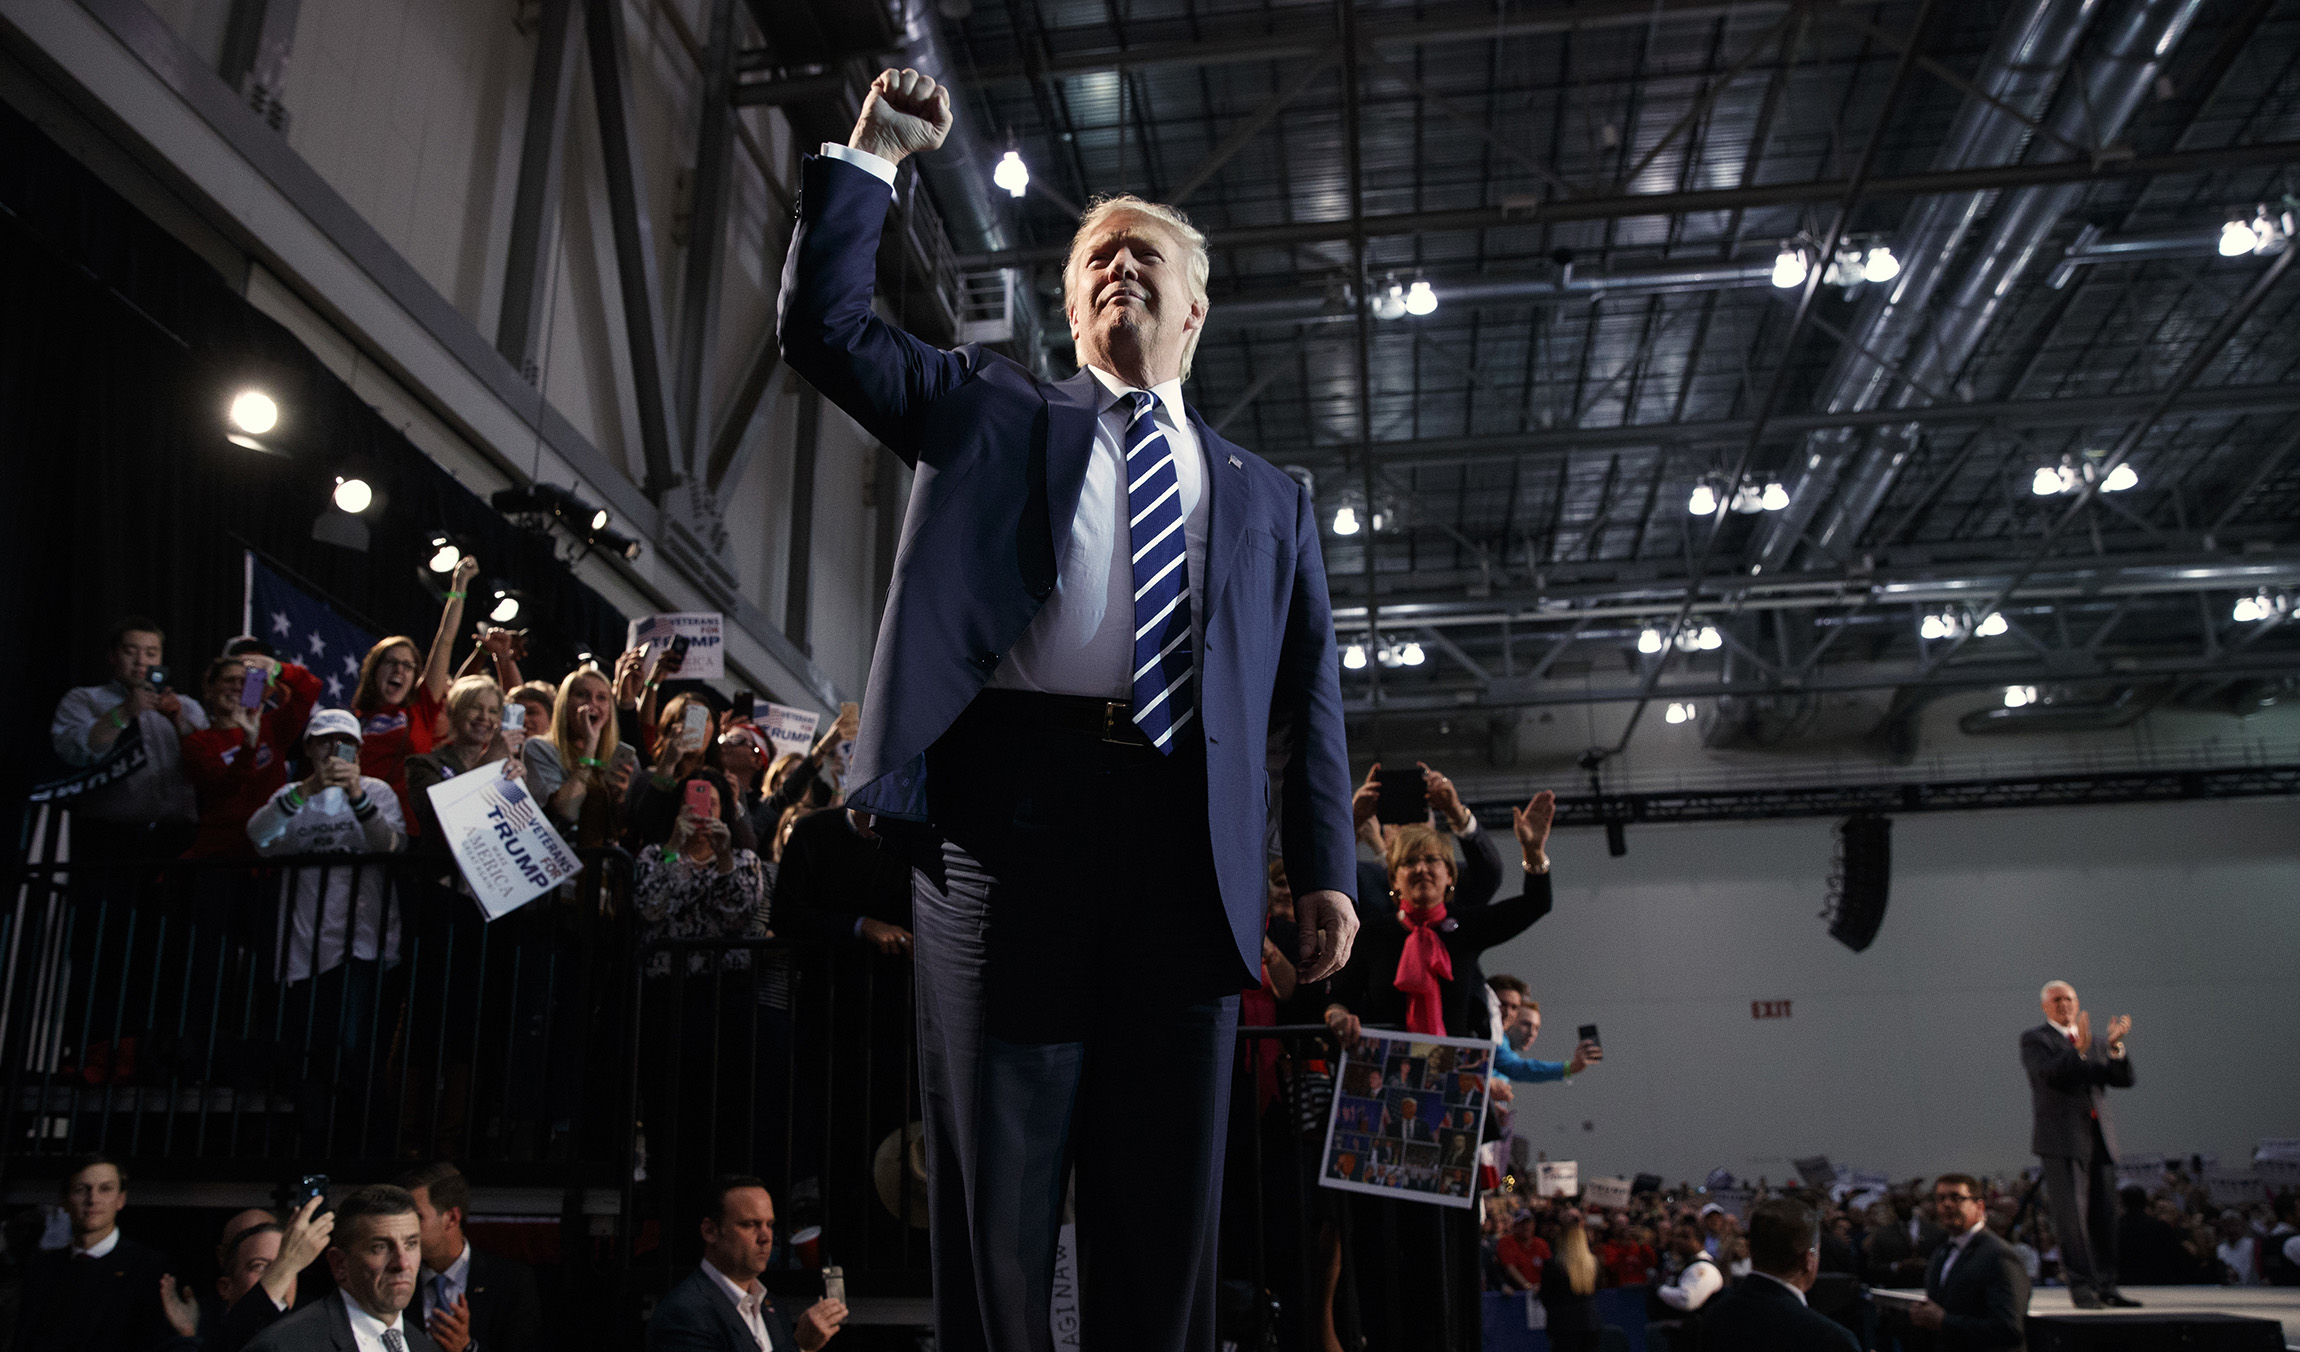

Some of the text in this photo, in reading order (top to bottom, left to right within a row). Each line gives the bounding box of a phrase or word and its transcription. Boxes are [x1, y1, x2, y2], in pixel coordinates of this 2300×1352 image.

[651, 635, 720, 648] TMP
[463, 825, 515, 898] AMERICA
[487, 805, 549, 889] TRUMP
[528, 817, 574, 874] VETERANS
[540, 857, 563, 880] FOR
[1751, 1000, 1792, 1019] EXIT
